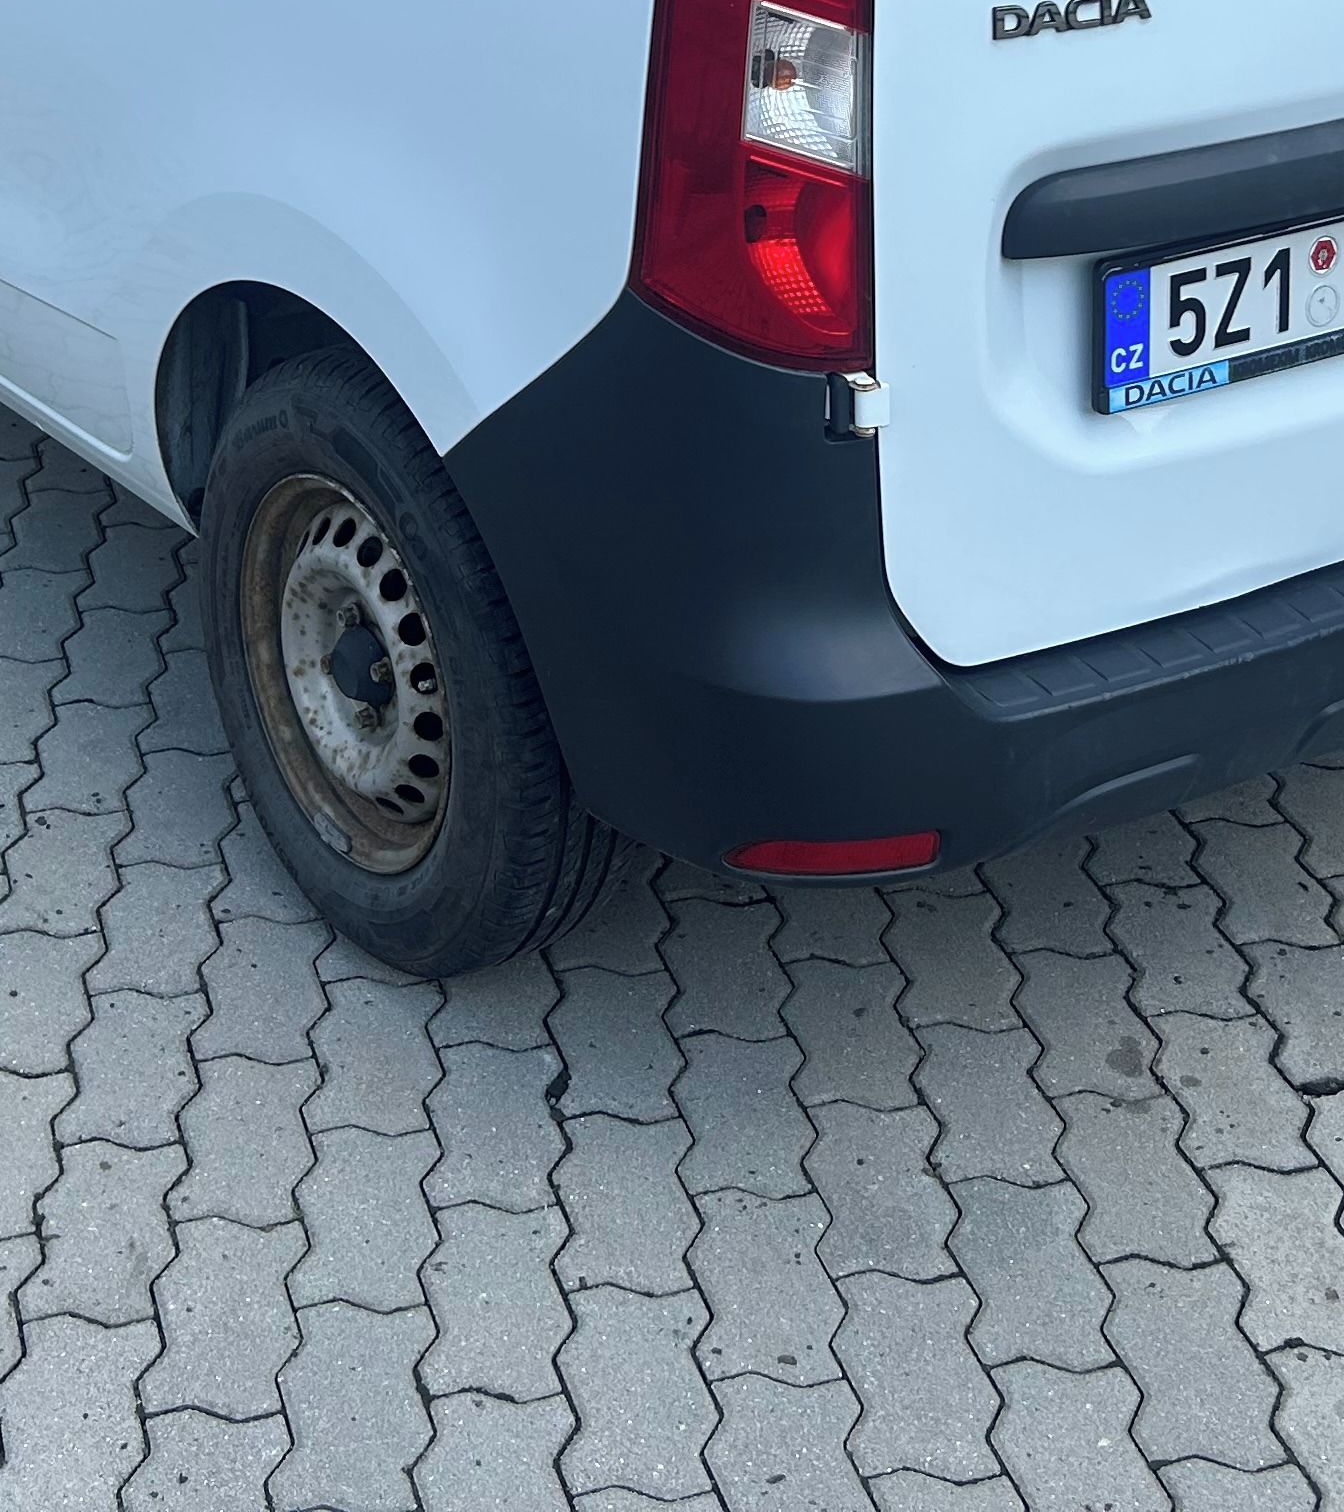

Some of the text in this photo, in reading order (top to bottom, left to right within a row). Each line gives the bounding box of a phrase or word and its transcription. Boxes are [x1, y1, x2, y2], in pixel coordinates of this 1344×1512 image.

[1168, 246, 1293, 357] 5Z1
[1109, 343, 1144, 374] CZ
[1123, 366, 1218, 407] DACIA
